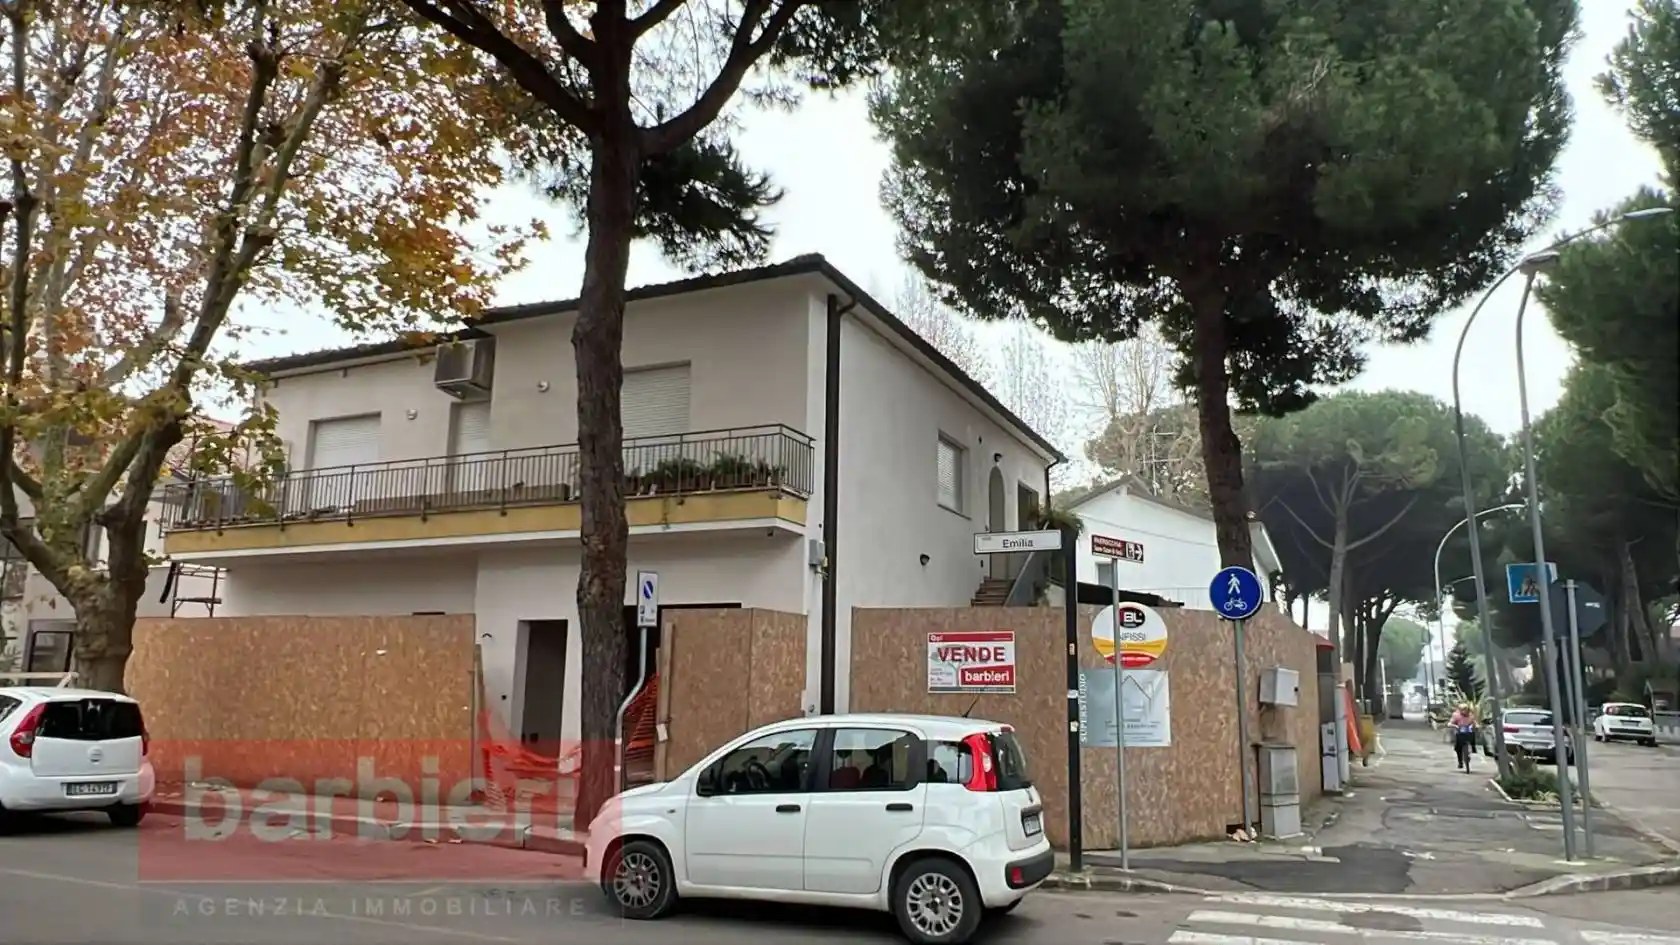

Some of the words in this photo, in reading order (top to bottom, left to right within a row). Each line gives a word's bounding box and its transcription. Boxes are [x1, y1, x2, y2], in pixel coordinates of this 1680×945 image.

[1002, 538, 1034, 548] Emilia
[938, 646, 1005, 662] VENDE
[965, 671, 1010, 682] barbieri
[1079, 674, 1088, 744] SUPERSTUDIO
